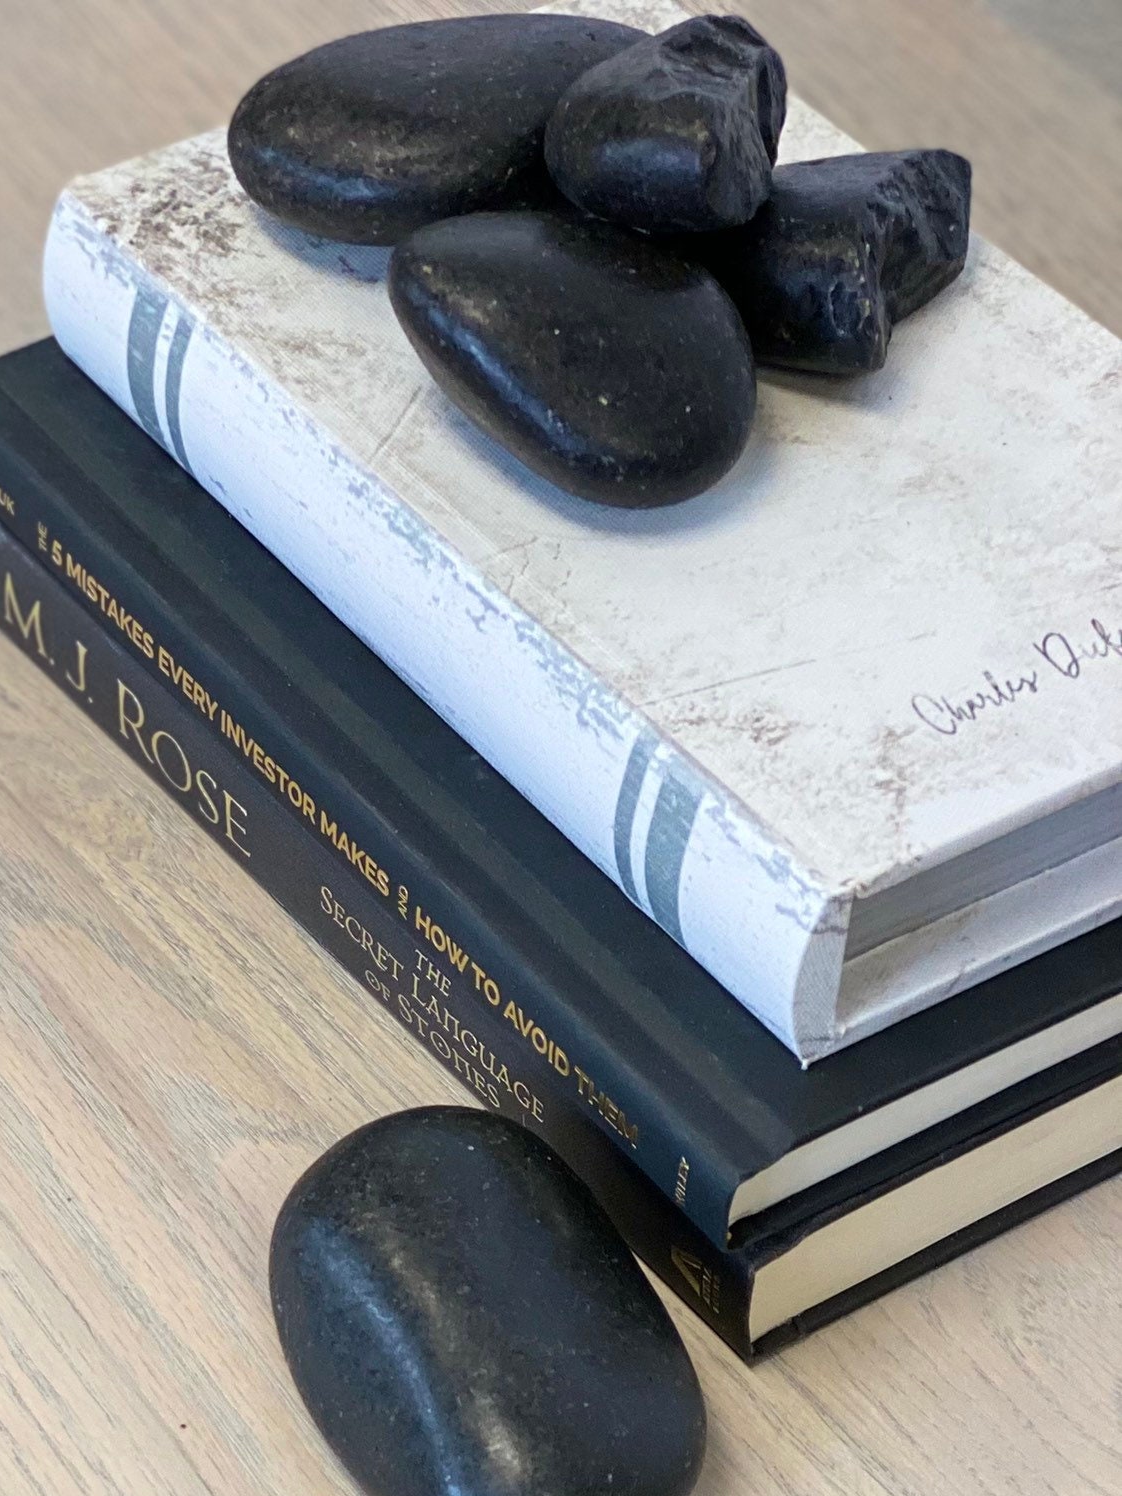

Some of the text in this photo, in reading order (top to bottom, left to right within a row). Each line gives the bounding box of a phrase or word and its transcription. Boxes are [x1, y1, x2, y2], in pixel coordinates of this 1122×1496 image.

[4, 572, 251, 858] M. J. ROSE
[911, 670, 1038, 736] Charles
[37, 521, 640, 1150] THE 5 MISTAKES EVERY INVESTOR MAKES AND HOW TO AVOID THEM
[320, 886, 545, 1124] SECRET LANGUAGE
[364, 969, 501, 1109] OF STONES
[415, 949, 453, 997] THE
